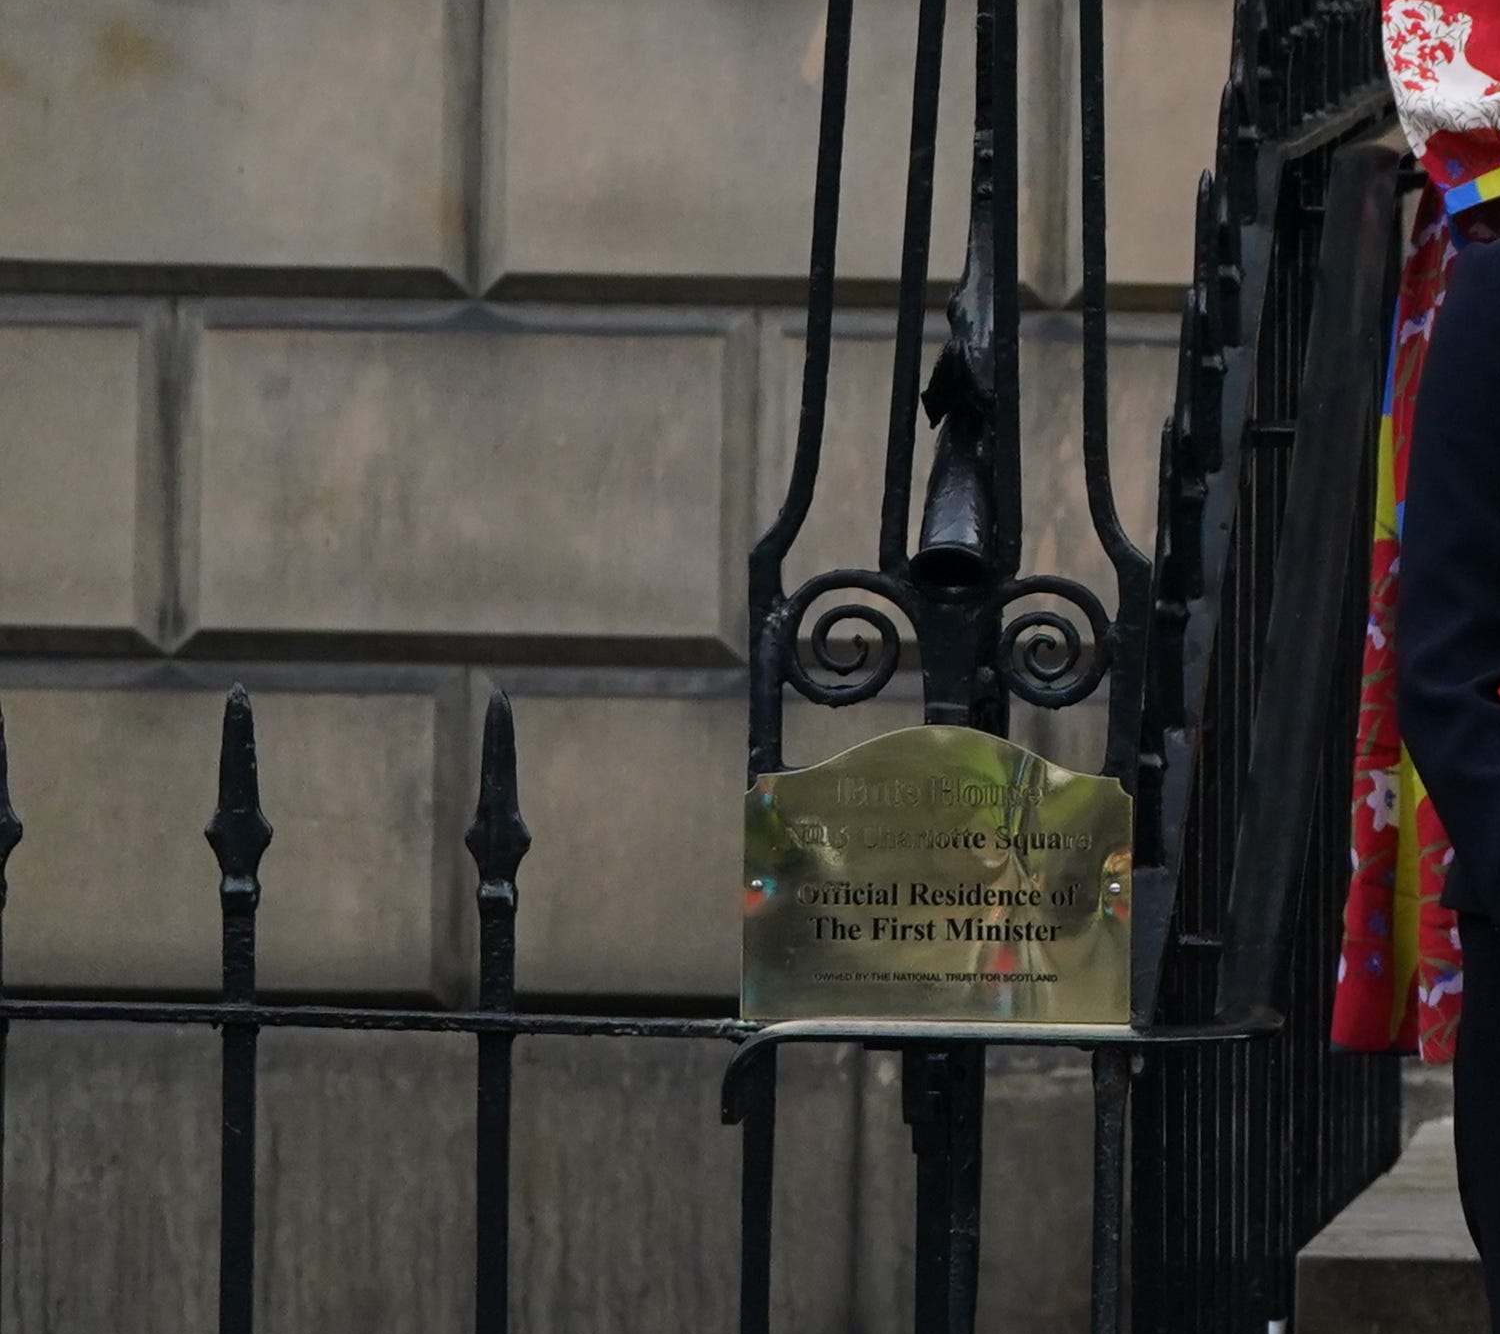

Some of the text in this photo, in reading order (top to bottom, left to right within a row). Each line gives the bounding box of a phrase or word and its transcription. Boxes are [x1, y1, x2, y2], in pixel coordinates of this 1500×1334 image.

[928, 774, 1043, 806] House
[995, 825, 1092, 855] Square
[798, 881, 1080, 907] Official Residence of
[809, 916, 1062, 942] The First Minister
[855, 972, 869, 982] BY
[871, 972, 891, 982] THE
[893, 972, 942, 982] NATIONAL
[945, 973, 978, 983] TRUST
[980, 973, 1000, 983] FOR
[1003, 973, 1058, 983] SCOTLAND
